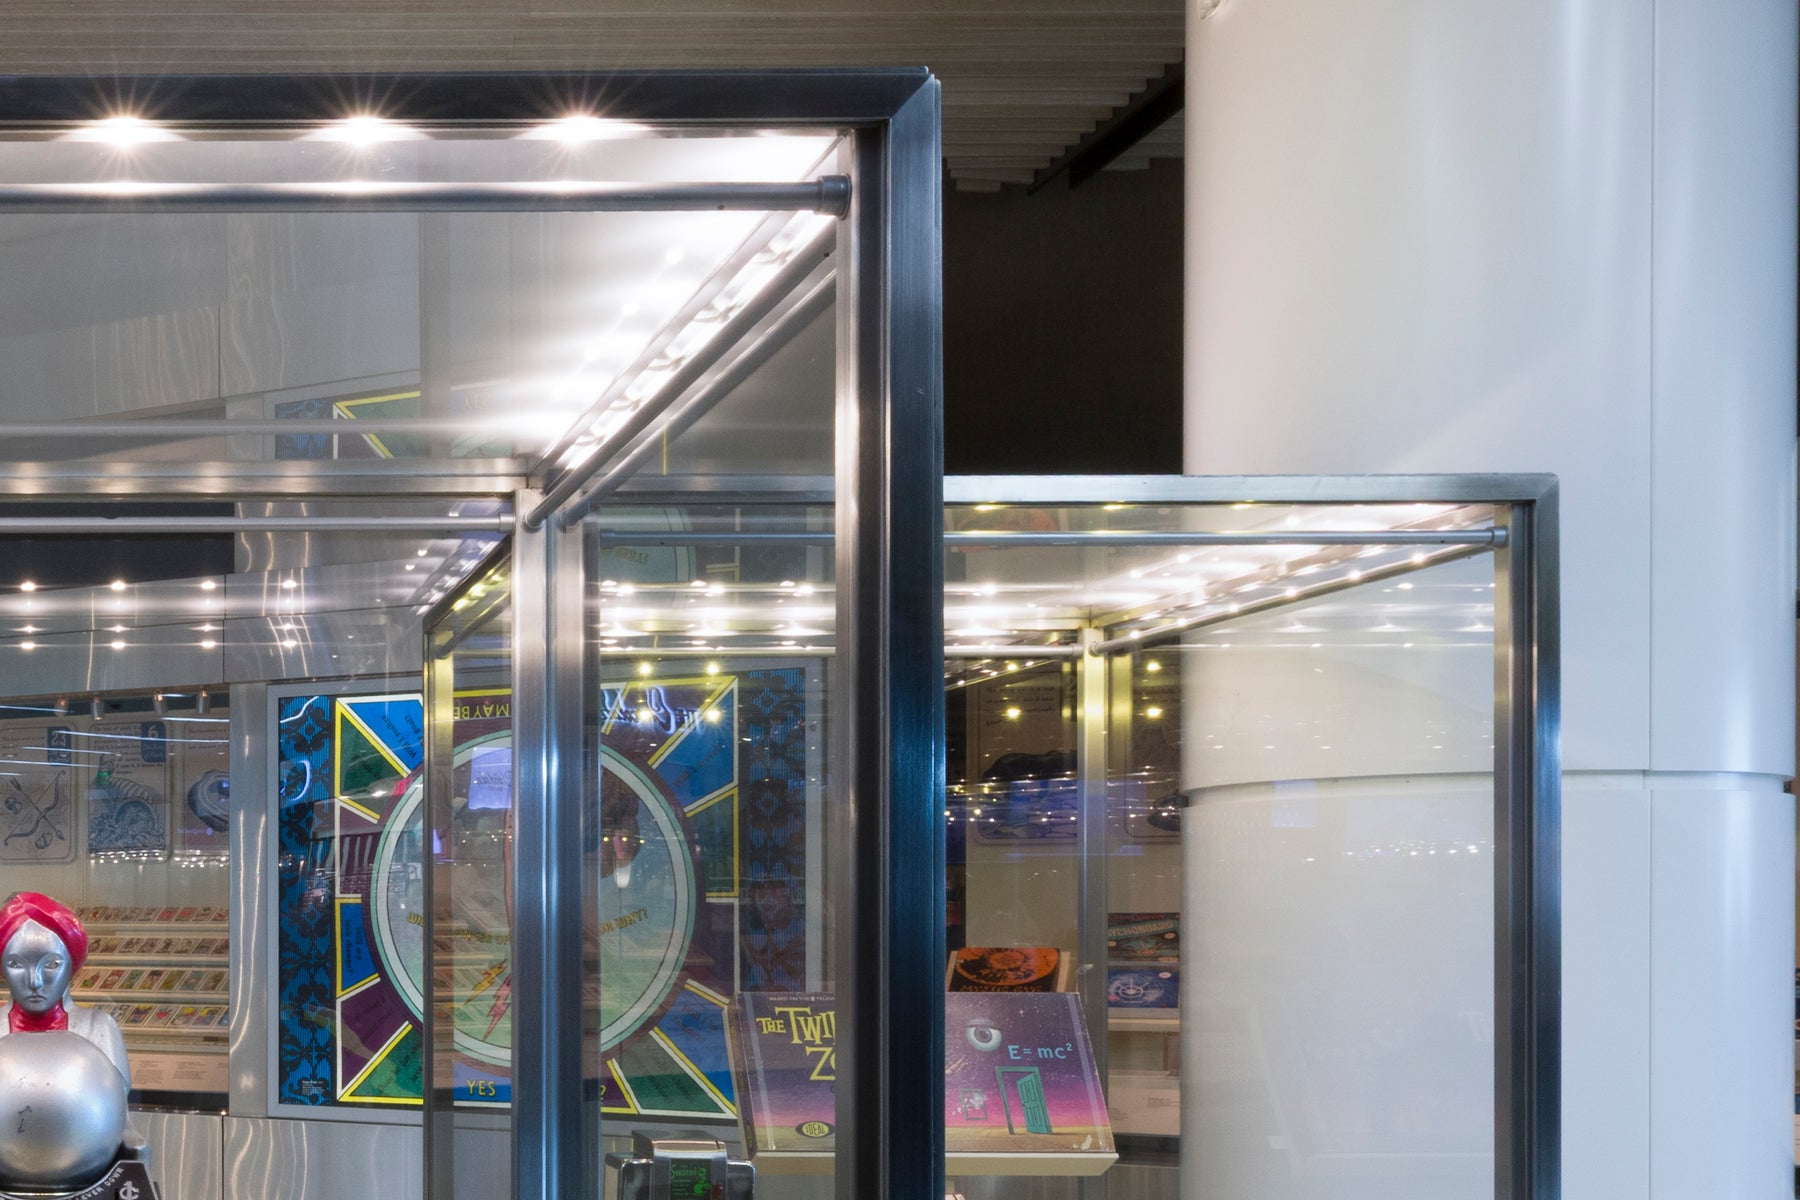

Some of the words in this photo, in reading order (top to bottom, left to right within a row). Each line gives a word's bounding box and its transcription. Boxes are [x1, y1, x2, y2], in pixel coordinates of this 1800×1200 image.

[453, 703, 509, 720] MAYBE
[50, 729, 67, 747] 23
[148, 724, 158, 740] 6
[756, 1017, 787, 1035] THE
[466, 1079, 496, 1096] YES
[805, 1121, 827, 1136] IDEAL
[104, 1166, 125, 1188] DOWN
